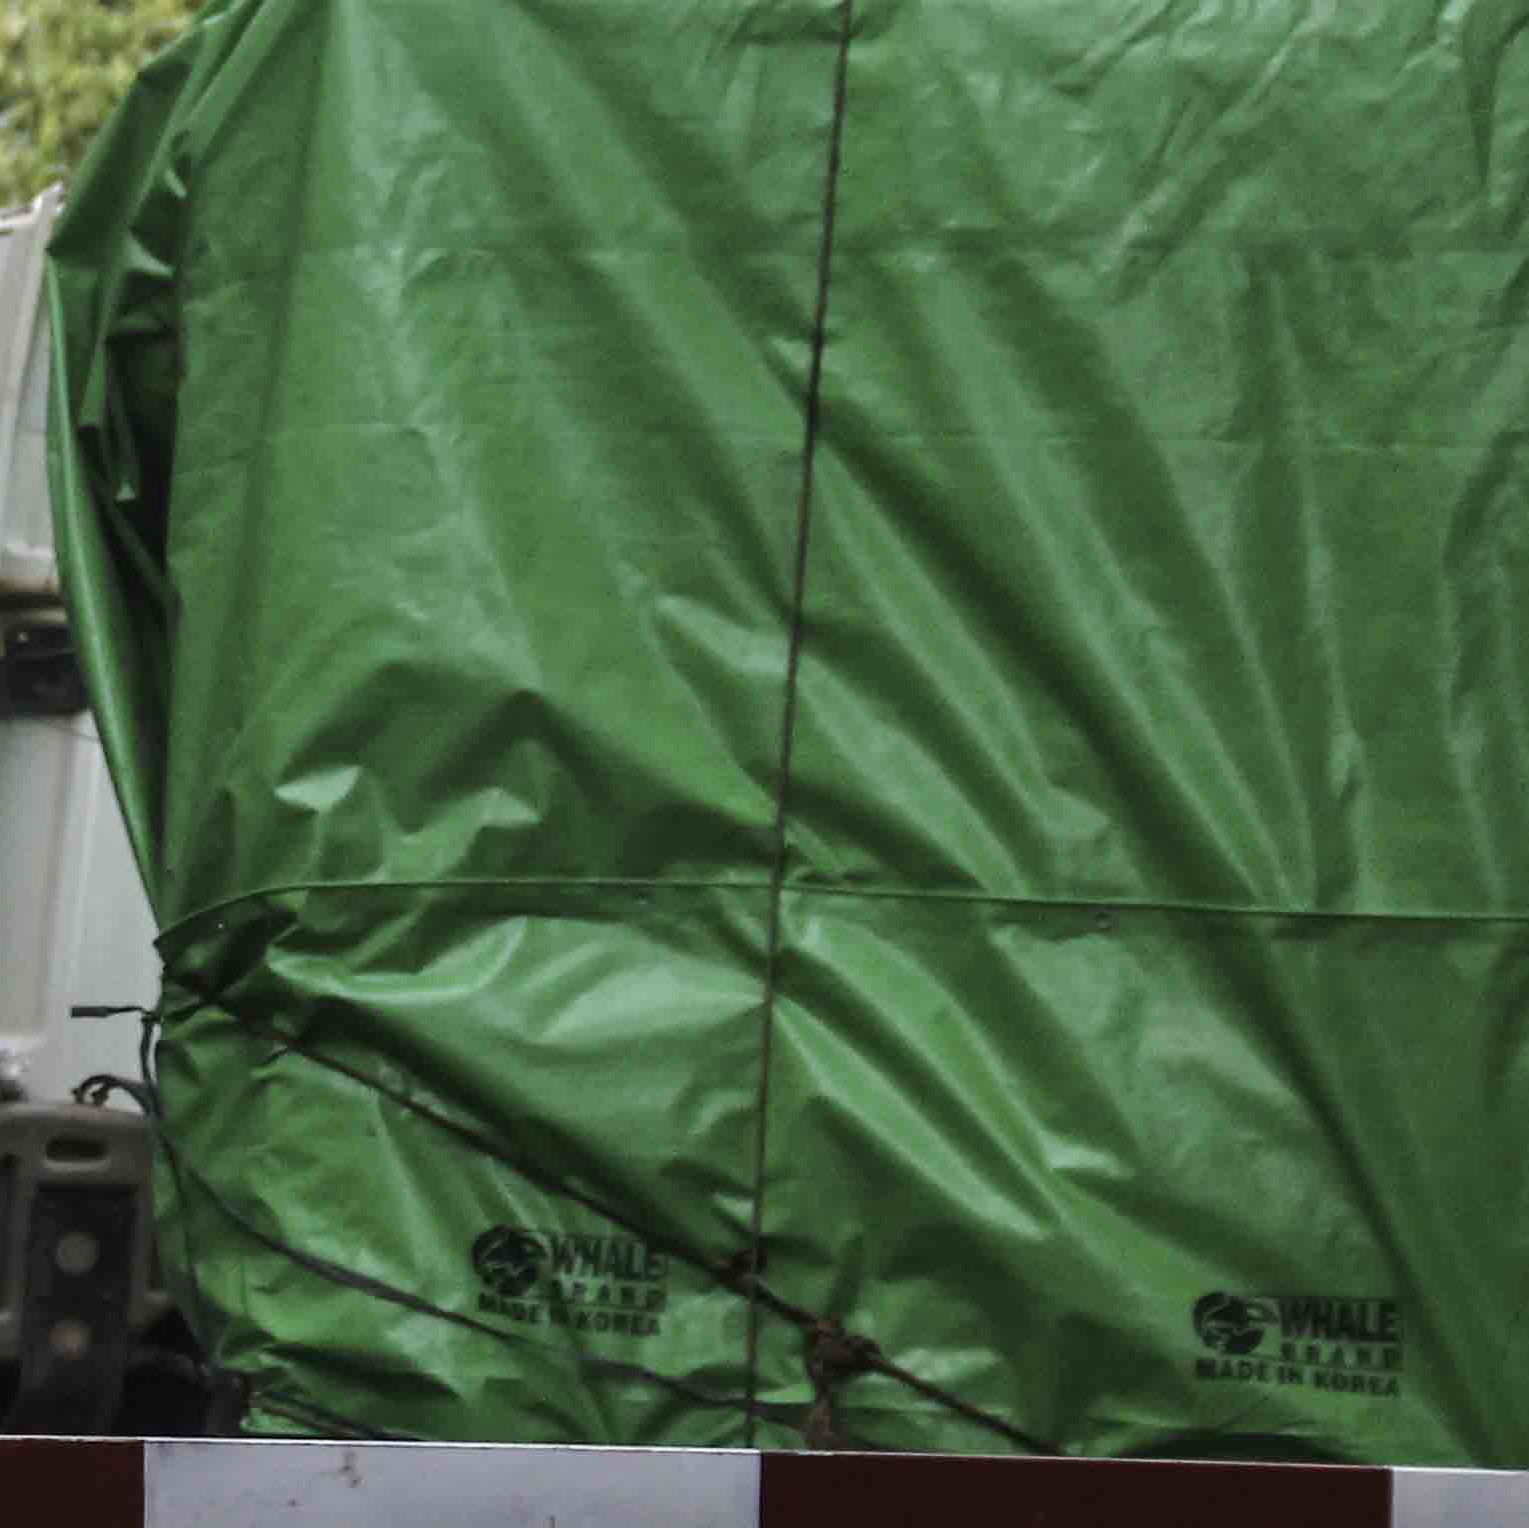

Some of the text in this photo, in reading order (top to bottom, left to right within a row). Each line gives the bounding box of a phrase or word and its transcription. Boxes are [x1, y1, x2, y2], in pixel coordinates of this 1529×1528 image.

[1279, 1296, 1401, 1341] WHALE
[1196, 1358, 1269, 1381] MADE
[1314, 1373, 1400, 1397] KOREA
